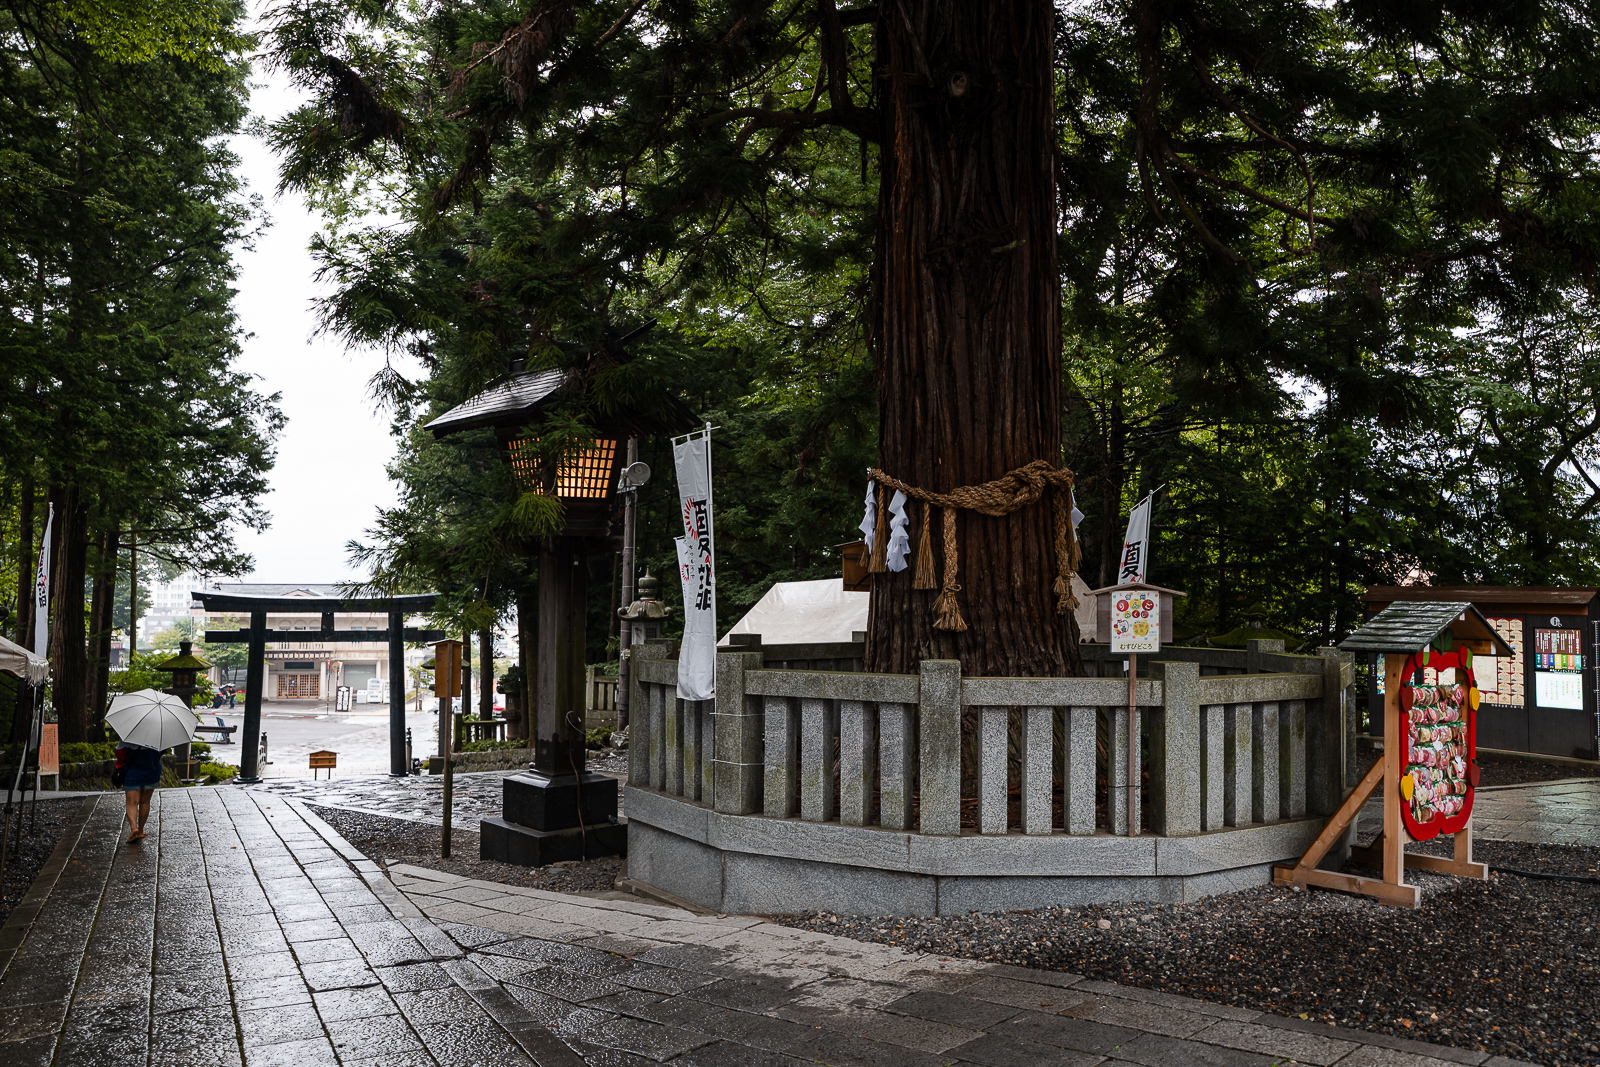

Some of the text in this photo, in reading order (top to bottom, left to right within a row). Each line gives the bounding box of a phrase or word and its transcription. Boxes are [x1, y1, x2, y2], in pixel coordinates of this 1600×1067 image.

[694, 499, 711, 611] 夏詣
[1121, 540, 1142, 581] 夏
[1118, 601, 1153, 611] りんご
